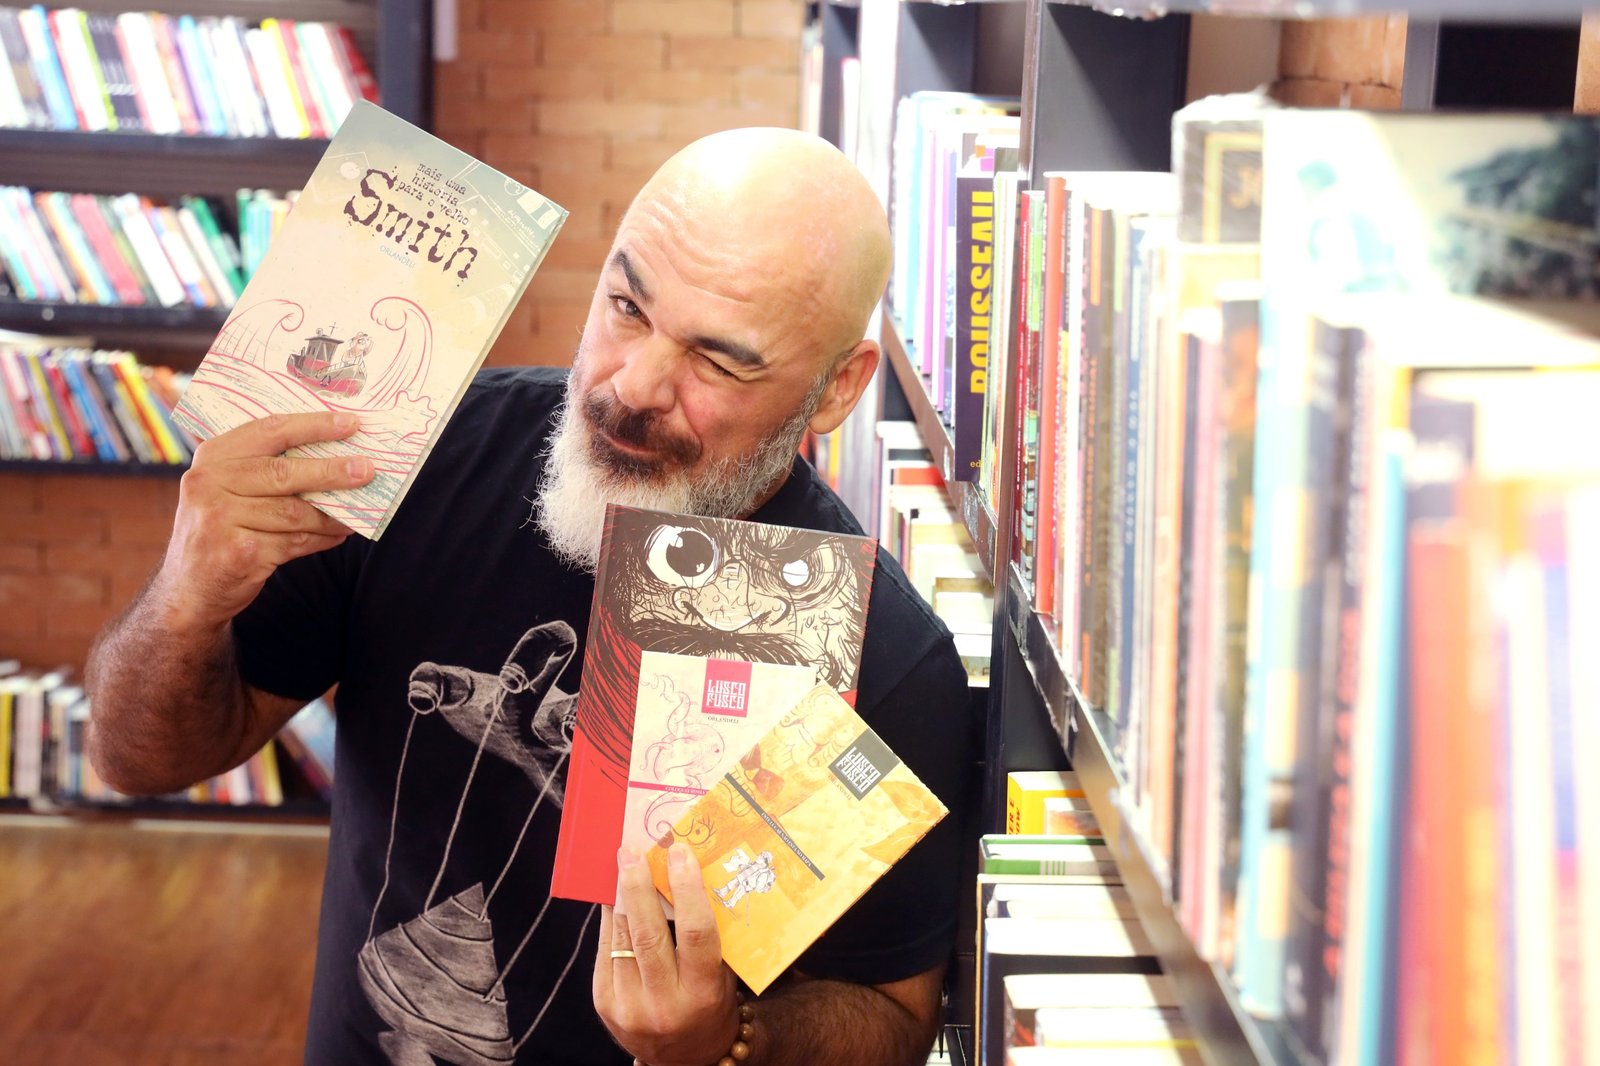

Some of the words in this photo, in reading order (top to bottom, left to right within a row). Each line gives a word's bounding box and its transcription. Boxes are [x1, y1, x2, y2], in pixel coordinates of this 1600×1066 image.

[417, 163, 442, 181] mais
[445, 180, 467, 195] uma
[395, 179, 424, 201] para
[427, 199, 435, 207] o
[440, 204, 469, 225] velho
[343, 168, 478, 280] Smith
[705, 692, 745, 710] FUSCO
[707, 679, 747, 696] LUSCO
[835, 756, 871, 794] FUSCO
[845, 746, 882, 784] LUSCO
